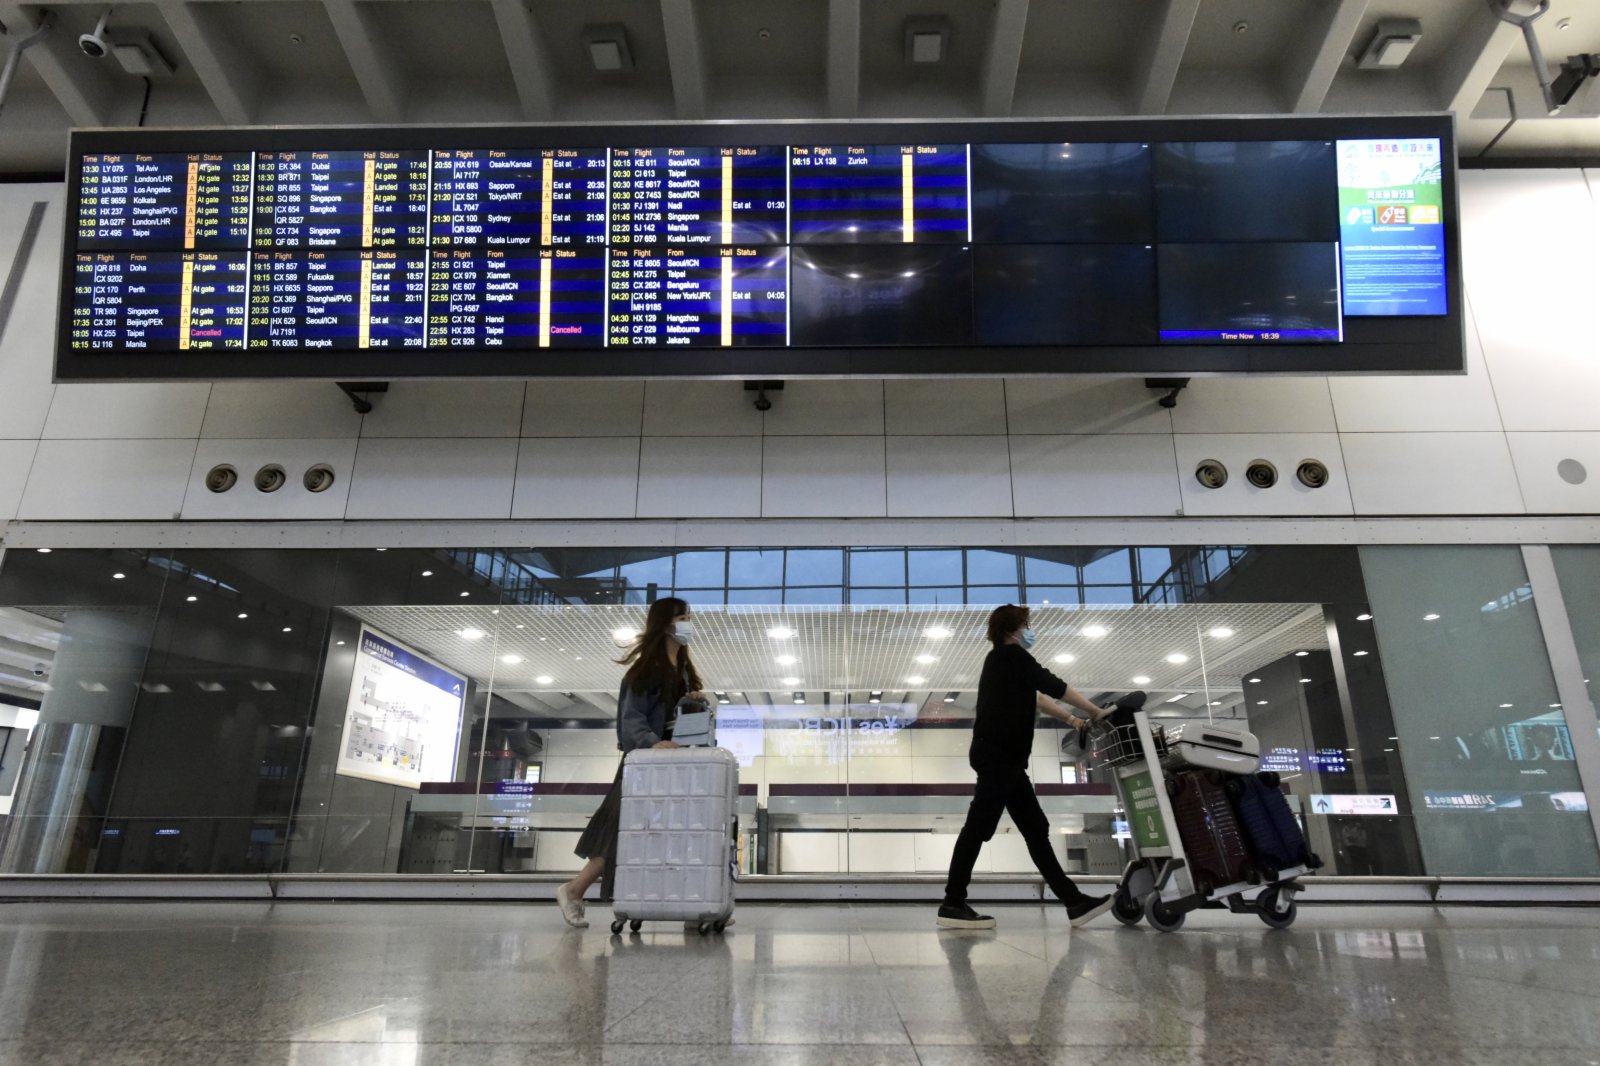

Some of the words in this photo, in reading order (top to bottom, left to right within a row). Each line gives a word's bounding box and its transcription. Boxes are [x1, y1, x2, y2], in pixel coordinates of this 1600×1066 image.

[456, 151, 473, 159] Flight
[635, 149, 651, 157] Flight
[814, 148, 831, 156] Flight
[279, 153, 296, 161] Flight
[814, 156, 823, 165] LX
[311, 195, 341, 203] Singapore
[489, 193, 522, 201] Tokyo/NRT
[133, 207, 177, 216] Shanghai/PVG
[310, 206, 336, 214] Bangkok
[488, 215, 511, 223] Sydney
[668, 213, 699, 221] Singapore
[309, 227, 340, 236] Singapore
[275, 253, 292, 261] Flight
[454, 251, 470, 259] Flight
[634, 250, 650, 258] Flight
[487, 261, 505, 269] Taipei
[667, 270, 685, 279] Taipei
[307, 295, 352, 303] Shanghai/PVG
[486, 294, 513, 302] Bangkok
[127, 308, 158, 316] Singapore
[127, 319, 163, 327] Beijing/PEK
[486, 327, 504, 335] Taipei
[305, 339, 332, 348] Bangkok
